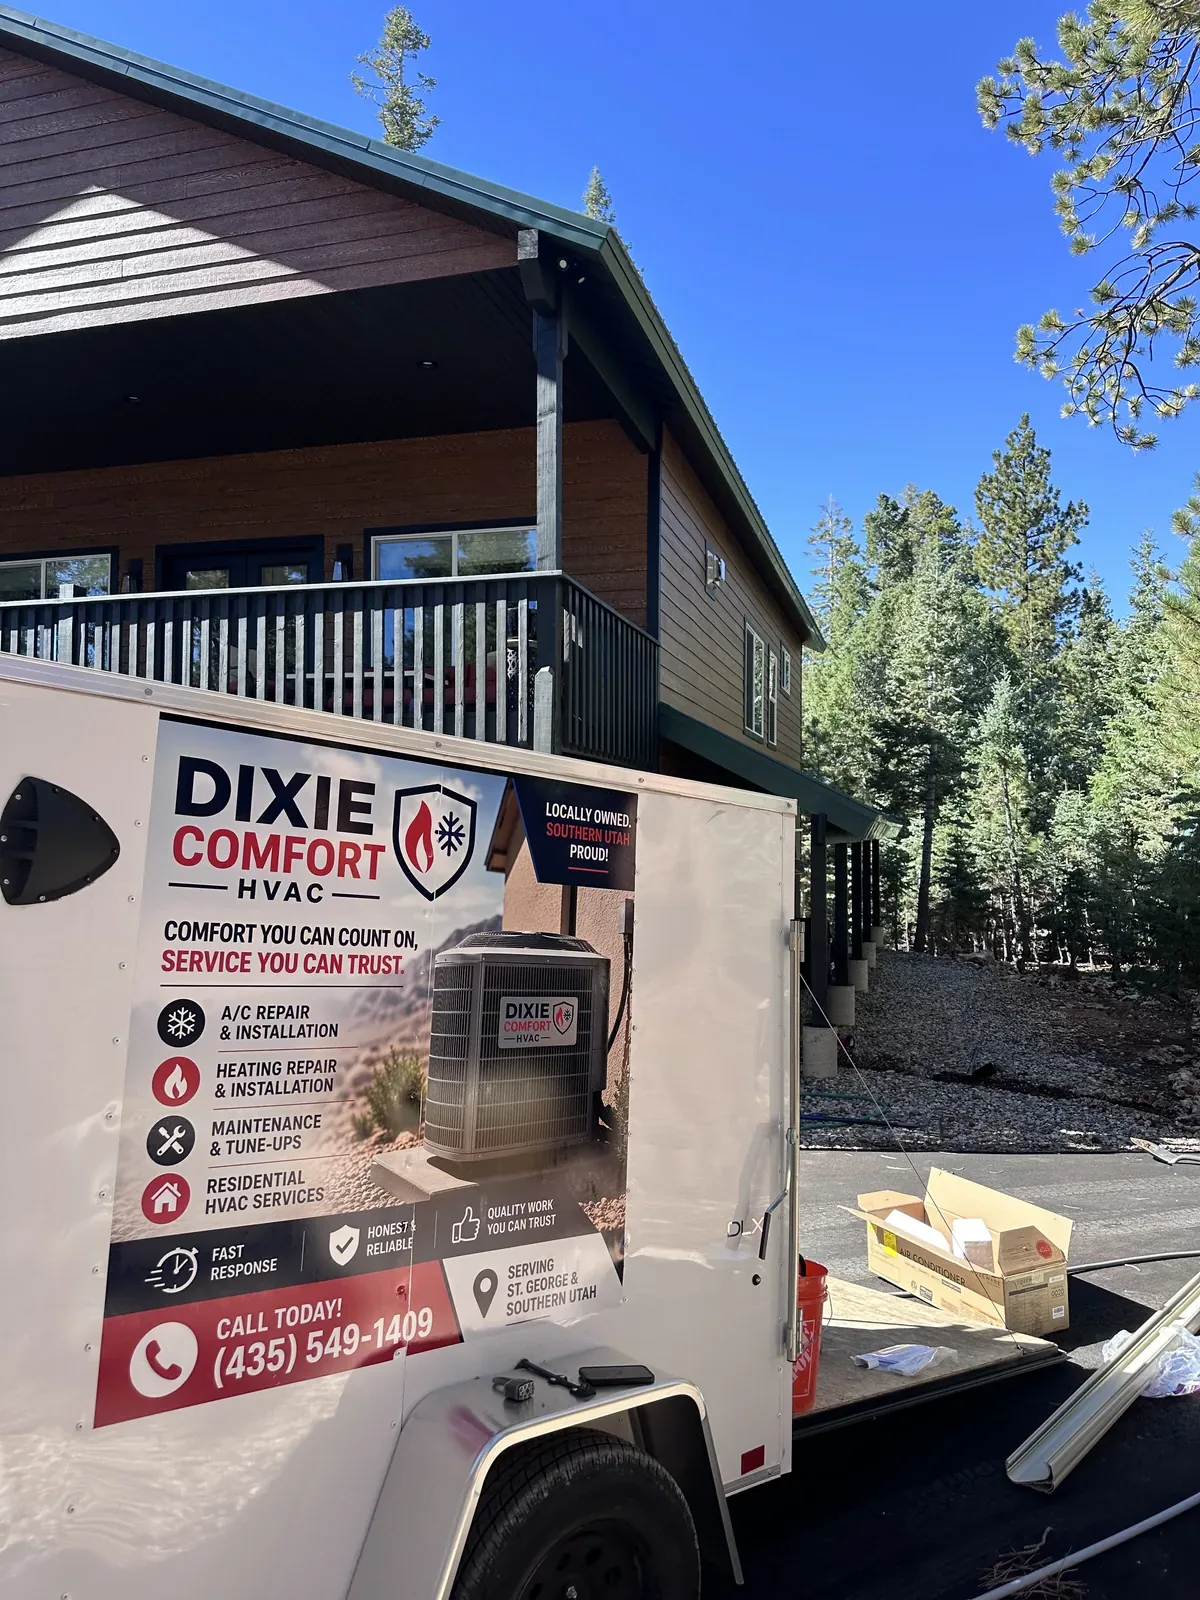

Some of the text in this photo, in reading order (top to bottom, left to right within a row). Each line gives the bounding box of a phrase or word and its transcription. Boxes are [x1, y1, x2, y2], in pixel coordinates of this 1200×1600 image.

[175, 756, 375, 835] DIXIE
[546, 802, 631, 828] LOCALLY OWNED.
[546, 822, 630, 845] SOUTHERN UTAH
[173, 825, 385, 880] COMFORT
[570, 844, 608, 861] PROUD!
[238, 879, 324, 903] HVAC
[164, 920, 418, 951] COMFORT YOU CAN COUNT ON,
[161, 950, 404, 975] SERVICE YOU CAN TRUST.
[221, 1005, 310, 1020] A/C REPAIR
[506, 1003, 549, 1018] DIXIE
[220, 1023, 338, 1040] & INSTALLATION
[504, 1020, 551, 1032] COMFORT
[516, 1034, 540, 1043] HVAC
[217, 1059, 337, 1078] HEATING REPAIR
[215, 1078, 333, 1098] & INSTALLATION
[211, 1115, 321, 1136] MAINTENANCE
[210, 1135, 302, 1156] & TUNE-UPS
[207, 1171, 305, 1194] RESIDENTIAL
[205, 1187, 324, 1214] HVAC SERVICES
[488, 1199, 553, 1218] QUALITY WORK
[368, 1221, 408, 1239] HONEST
[488, 1214, 556, 1235] YOU CAN TRUST
[727, 1216, 765, 1237] DLX
[212, 1245, 244, 1261] FAST
[367, 1237, 413, 1256] RELIABLE
[210, 1258, 278, 1281] RESPONSE
[508, 1258, 554, 1279] SERVING
[913, 1254, 965, 1286] CONDITIONER
[507, 1271, 578, 1297] ST. GEORGE &
[507, 1285, 596, 1316] SOUTHERN UTAH
[217, 1298, 342, 1339] CALL TODAY!
[214, 1308, 433, 1389] (435) 549-1409
